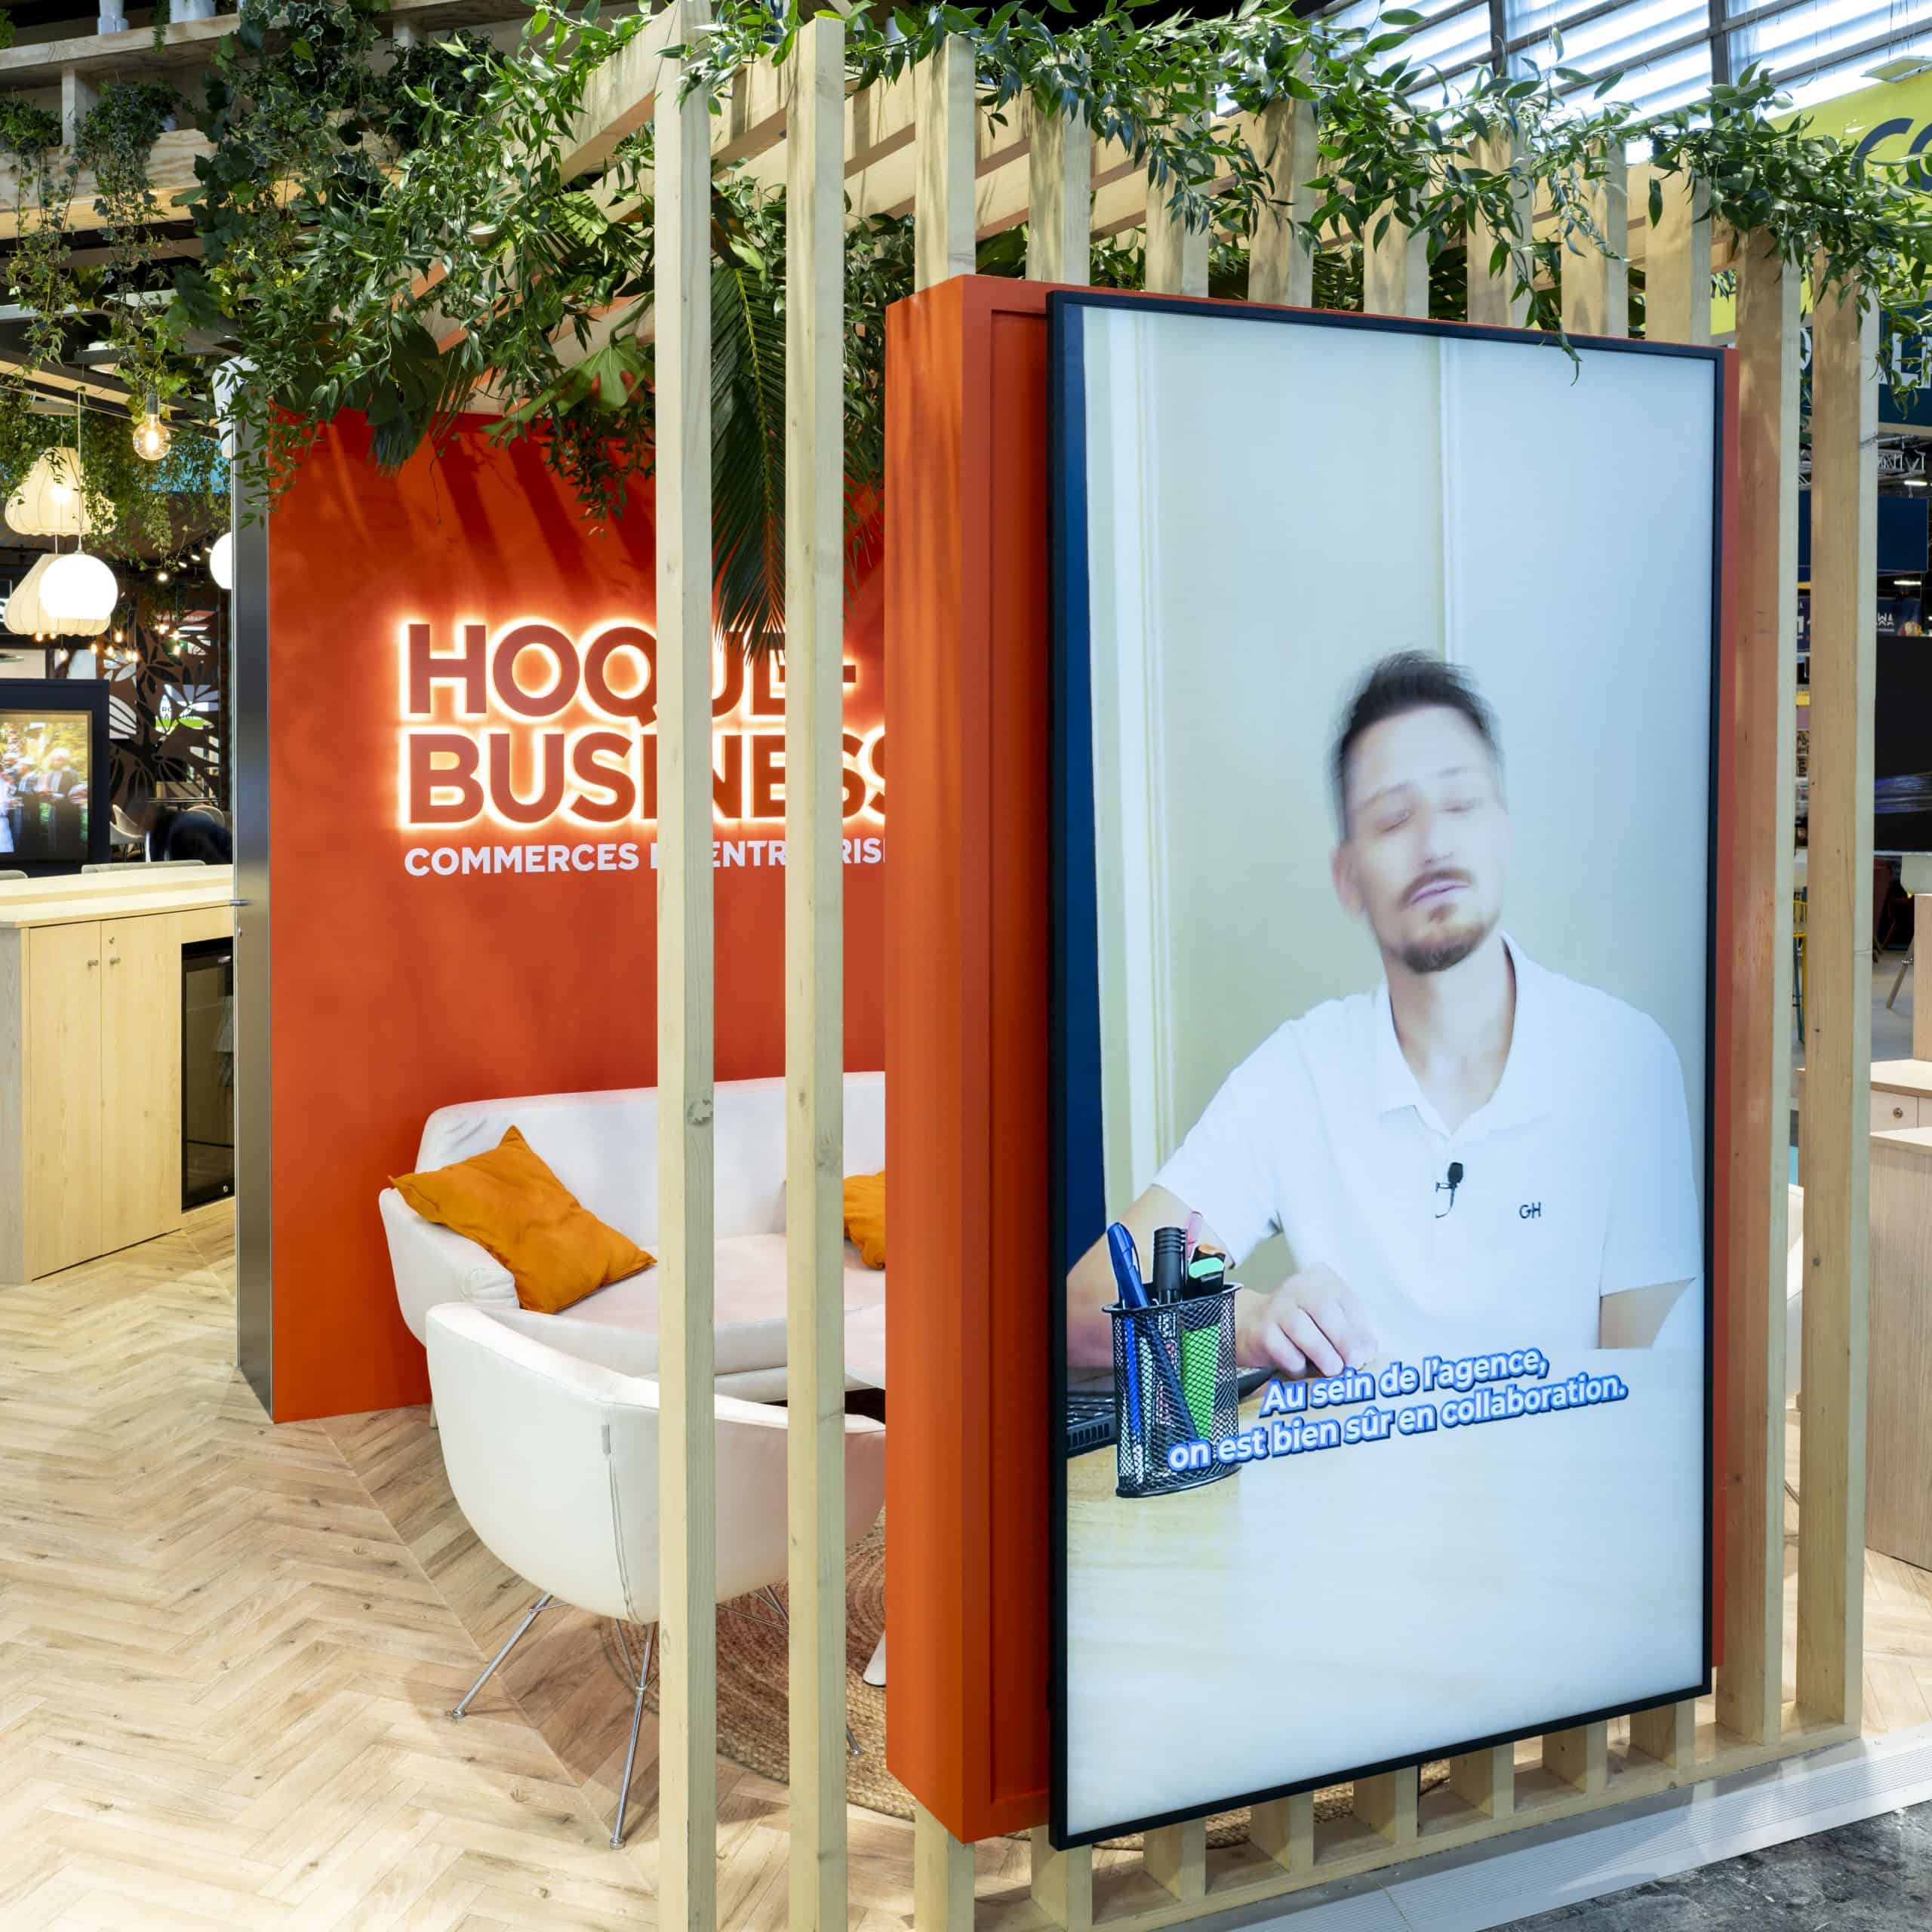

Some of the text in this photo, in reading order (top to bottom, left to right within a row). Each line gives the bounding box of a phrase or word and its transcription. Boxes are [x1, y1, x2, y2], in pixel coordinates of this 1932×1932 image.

[404, 841, 640, 876] COMMERCES
[1518, 1201, 1541, 1220] GH
[1260, 1380, 1306, 1417] Au
[1312, 1367, 1374, 1407] sein
[1380, 1361, 1420, 1395] de
[1169, 1373, 1627, 1471] on est bien sûr en collaboration.
